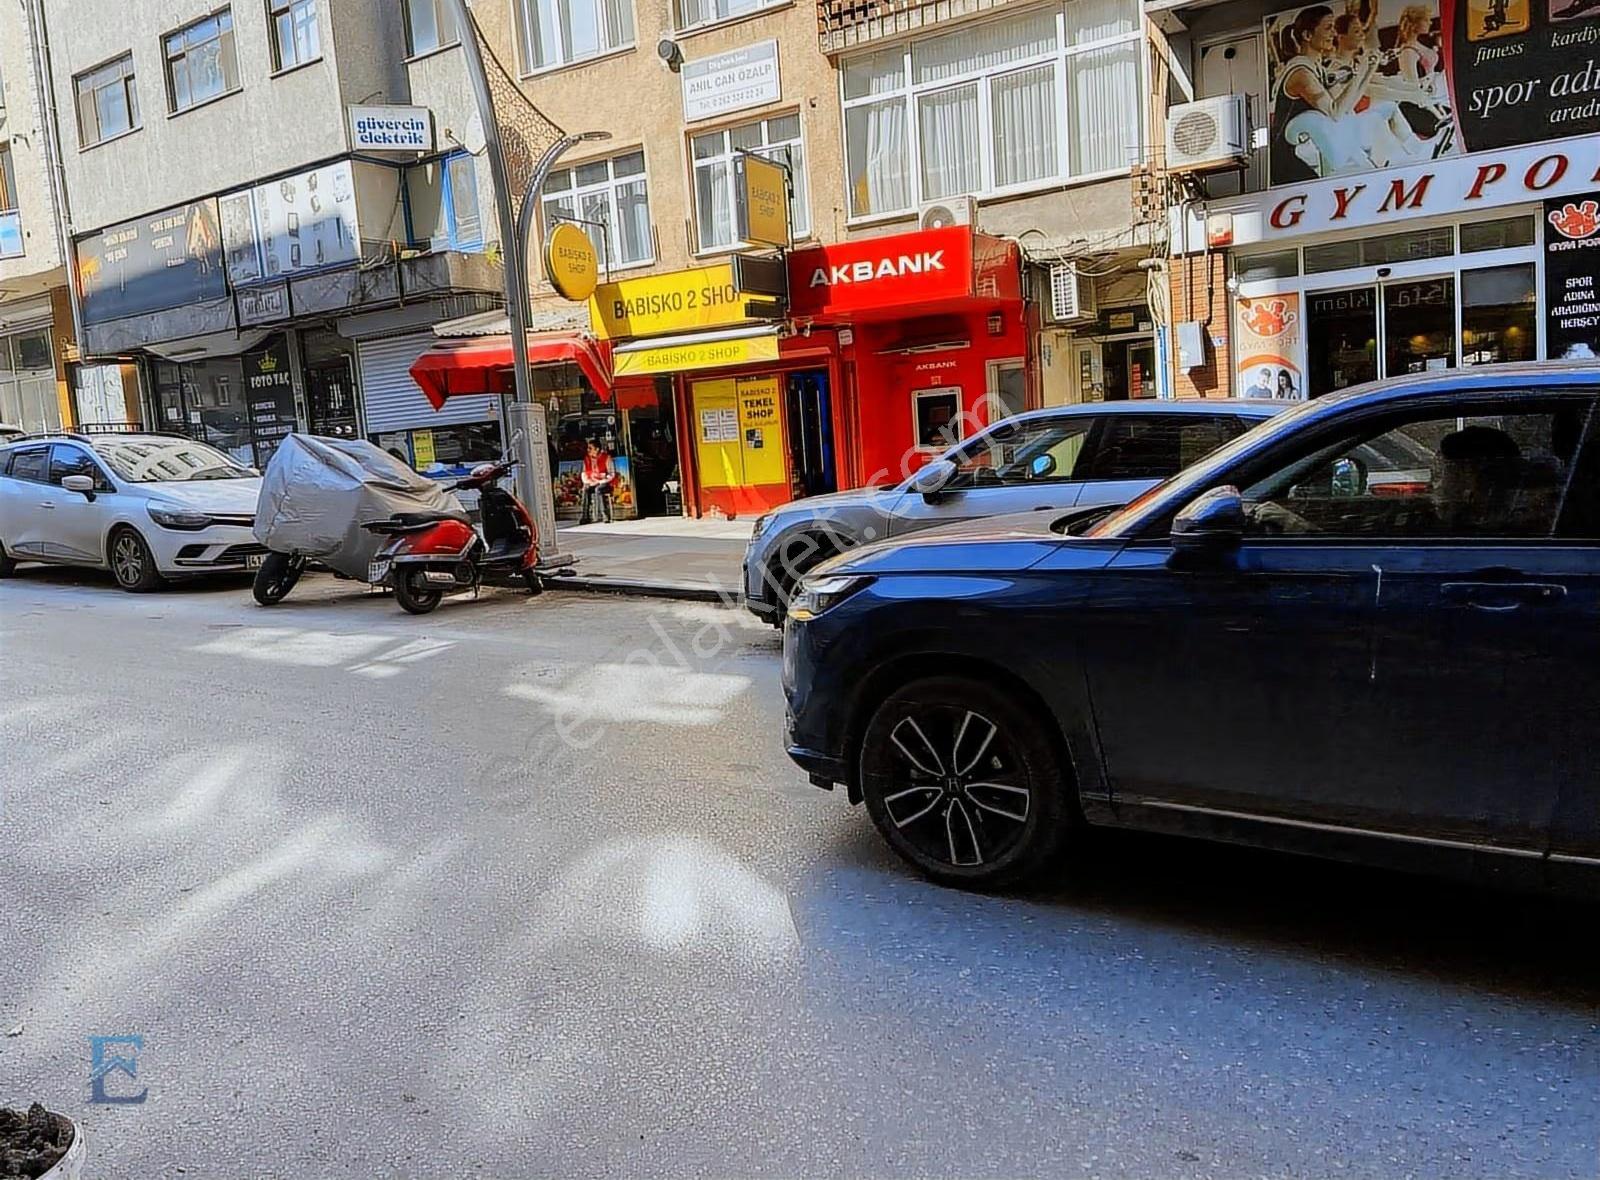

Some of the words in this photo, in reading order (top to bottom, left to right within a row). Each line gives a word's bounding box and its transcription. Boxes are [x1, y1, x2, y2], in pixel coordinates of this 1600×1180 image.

[1551, 26, 1600, 48] kardiy
[1473, 42, 1525, 66] fitness
[689, 76, 713, 95] ANIL
[714, 72, 736, 88] CAN
[1469, 79, 1541, 119] spor
[357, 117, 424, 133] güvercin
[360, 131, 424, 144] elektrik
[1270, 174, 1435, 229] GYM
[1464, 154, 1600, 200] PO
[1549, 240, 1576, 251] GYM
[568, 262, 586, 274] SHOP
[810, 250, 945, 288] AKBANK
[1565, 276, 1593, 289] SPOR
[687, 290, 697, 309] 2
[1563, 290, 1595, 302] ADINA
[698, 350, 706, 361] 2
[708, 345, 741, 360] SHOP
[915, 360, 958, 371] AKBANK
[743, 397, 775, 409] TEKEL
[746, 408, 774, 420] SHOP
